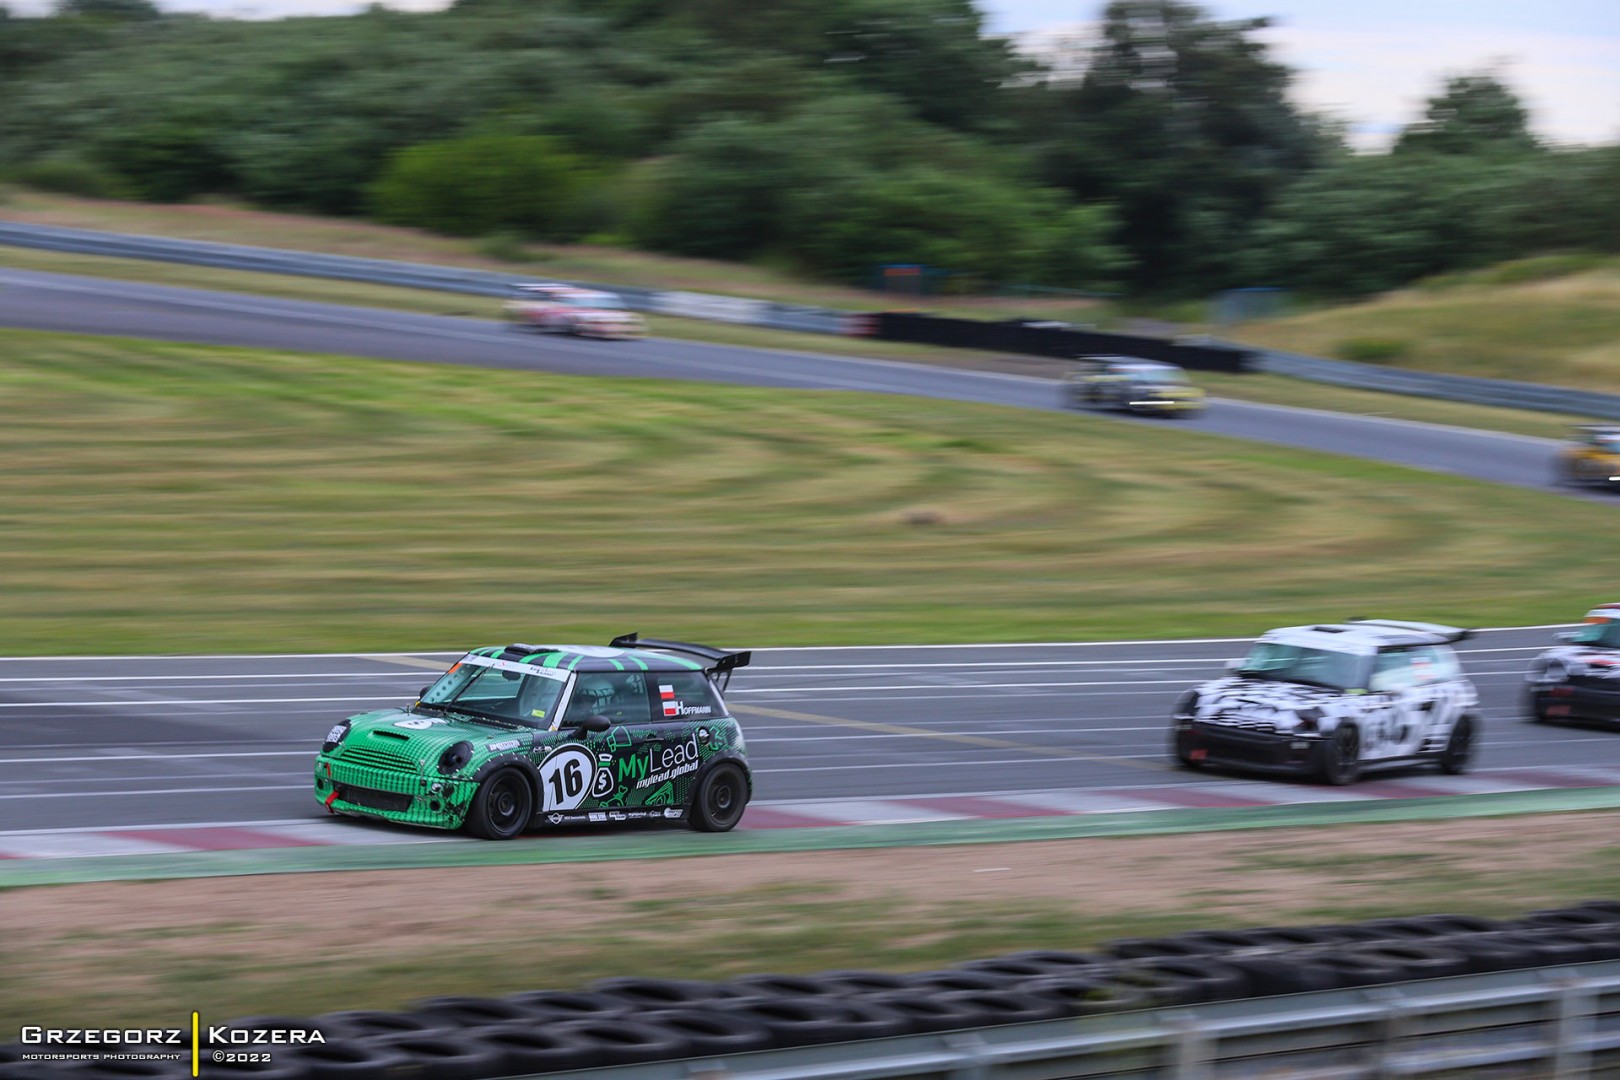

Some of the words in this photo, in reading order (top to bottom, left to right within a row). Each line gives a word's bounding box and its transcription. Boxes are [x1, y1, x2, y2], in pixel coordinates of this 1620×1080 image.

[618, 733, 699, 782] MyLead
[636, 760, 699, 790] mylead.global
[548, 758, 583, 805] 16
